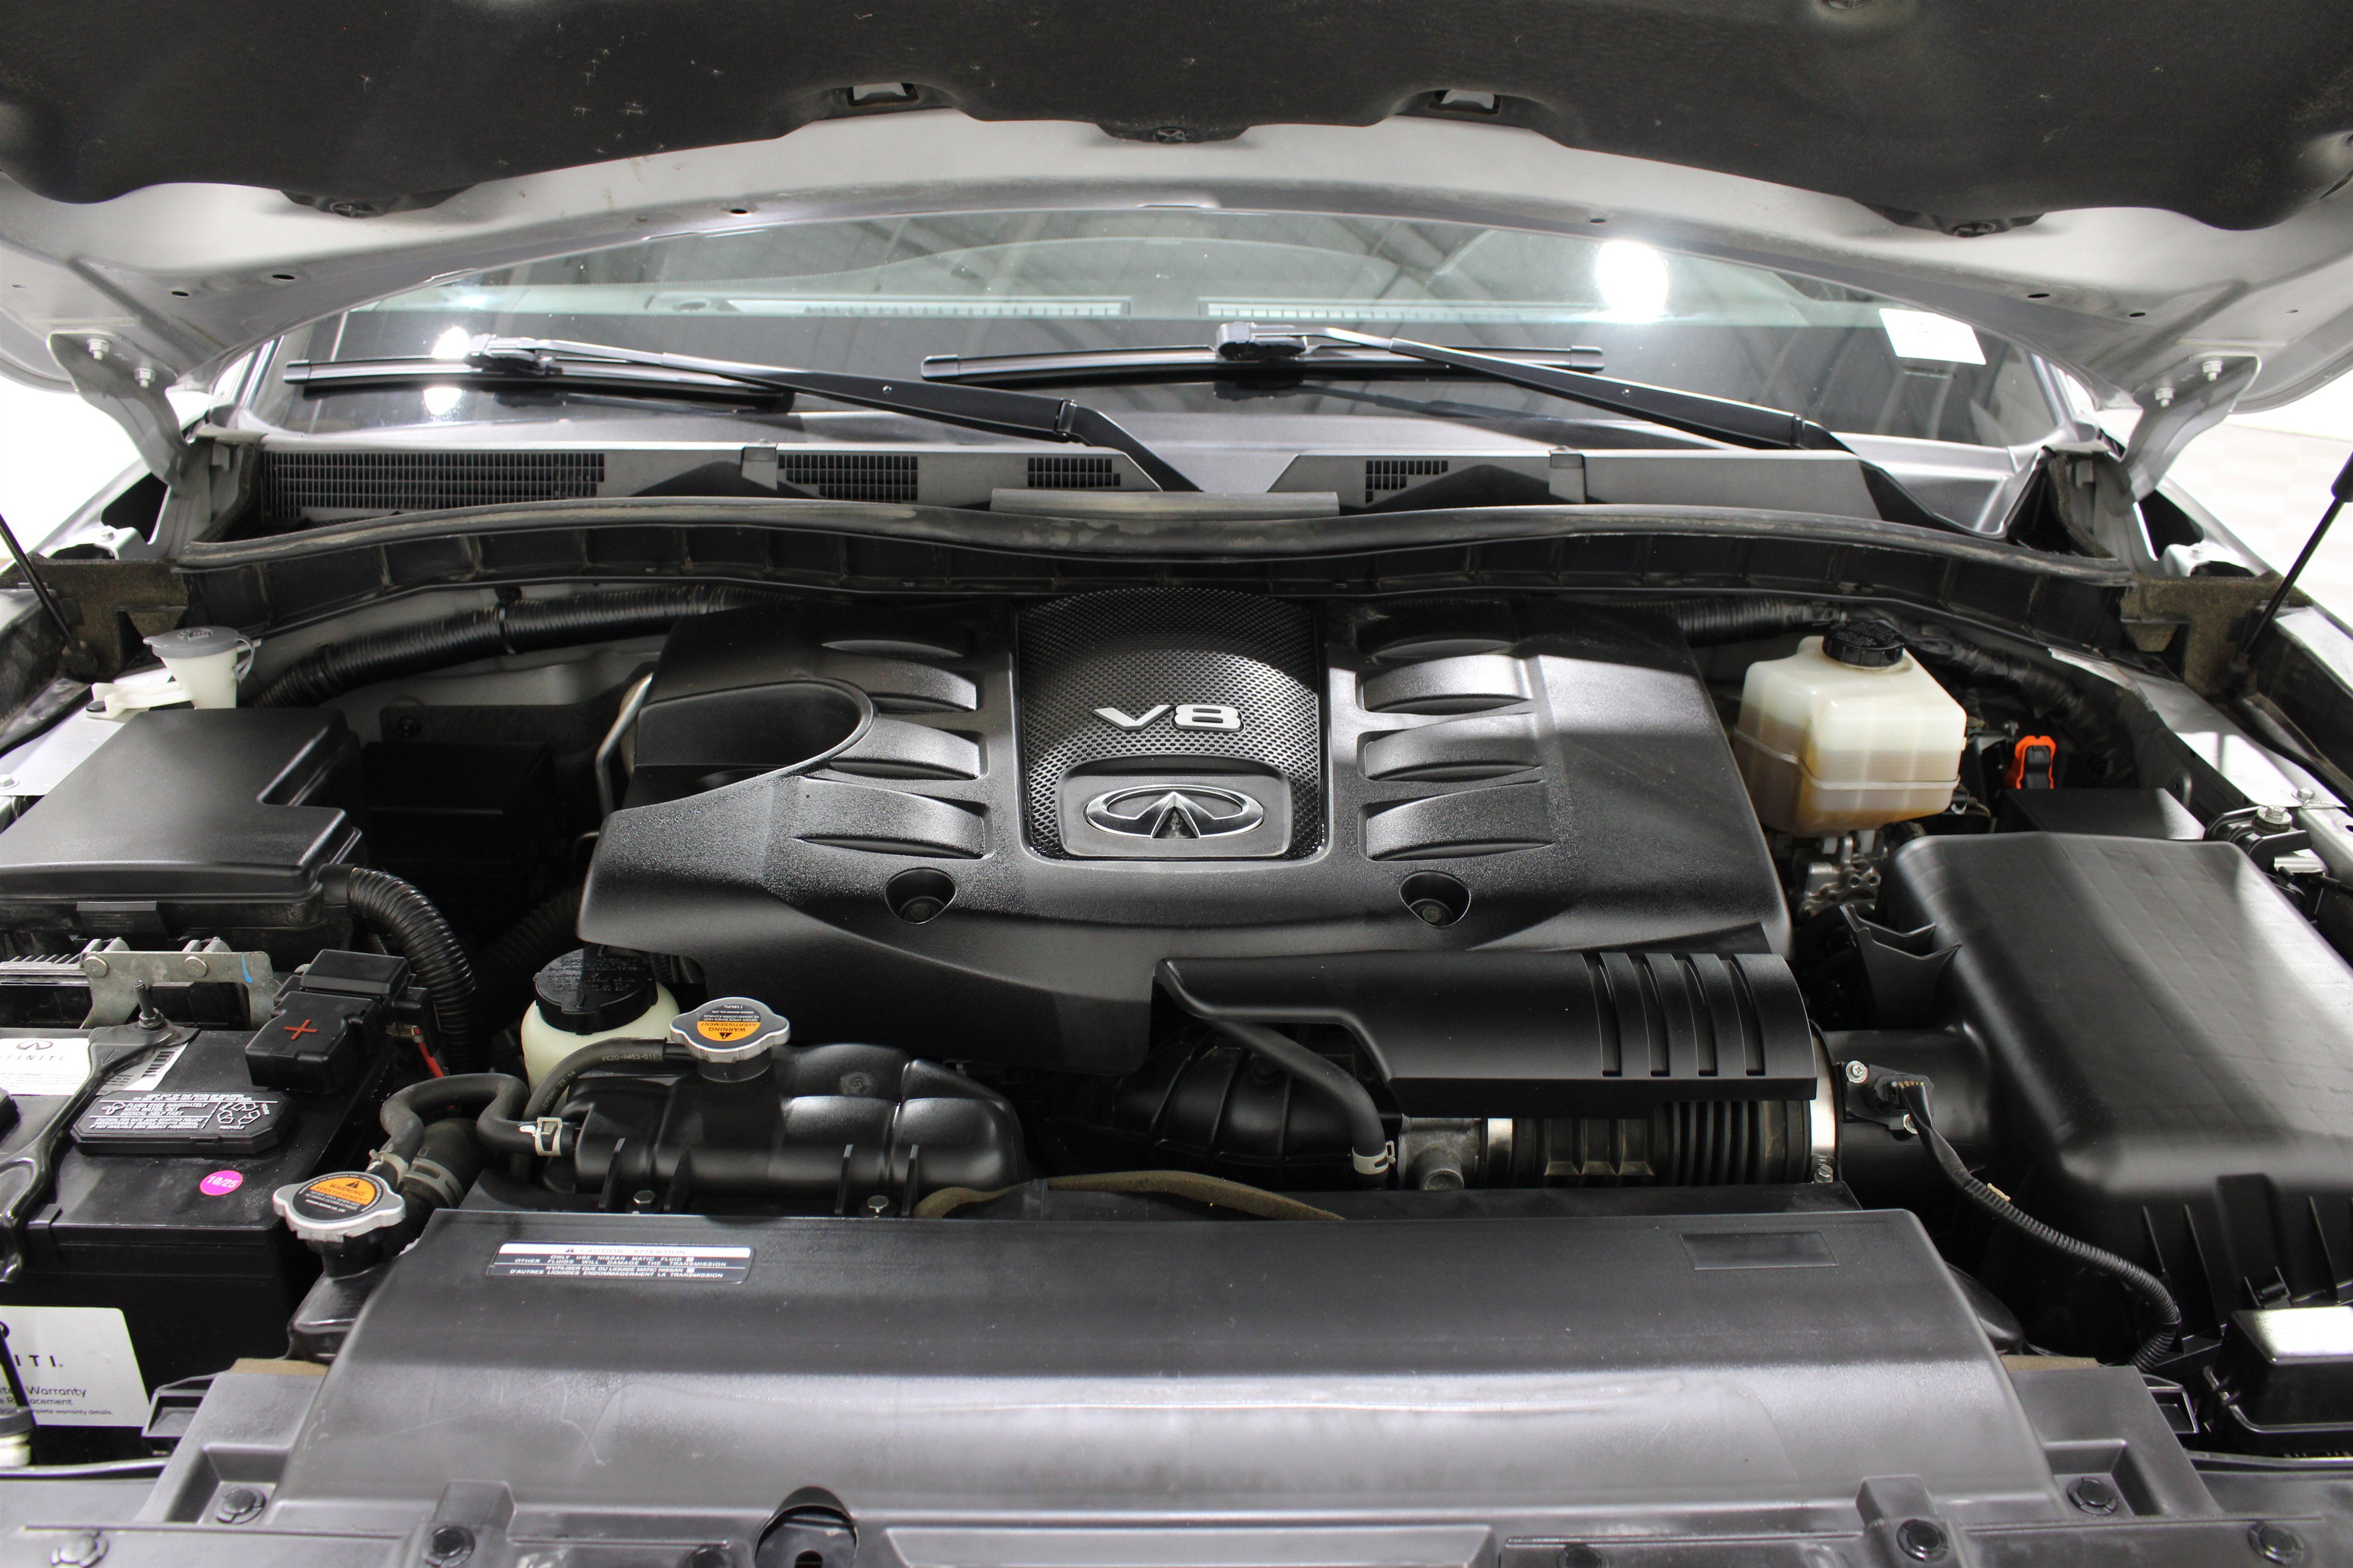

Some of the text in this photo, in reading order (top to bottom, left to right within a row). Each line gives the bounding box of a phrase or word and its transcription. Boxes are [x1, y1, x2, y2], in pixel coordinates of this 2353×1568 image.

[1093, 704, 1241, 732] V8
[207, 1176, 239, 1188] 10/25
[317, 1186, 368, 1202] AVERTISSEMENT
[330, 1183, 364, 1196] WARNING
[26, 1387, 86, 1398] Warranty
